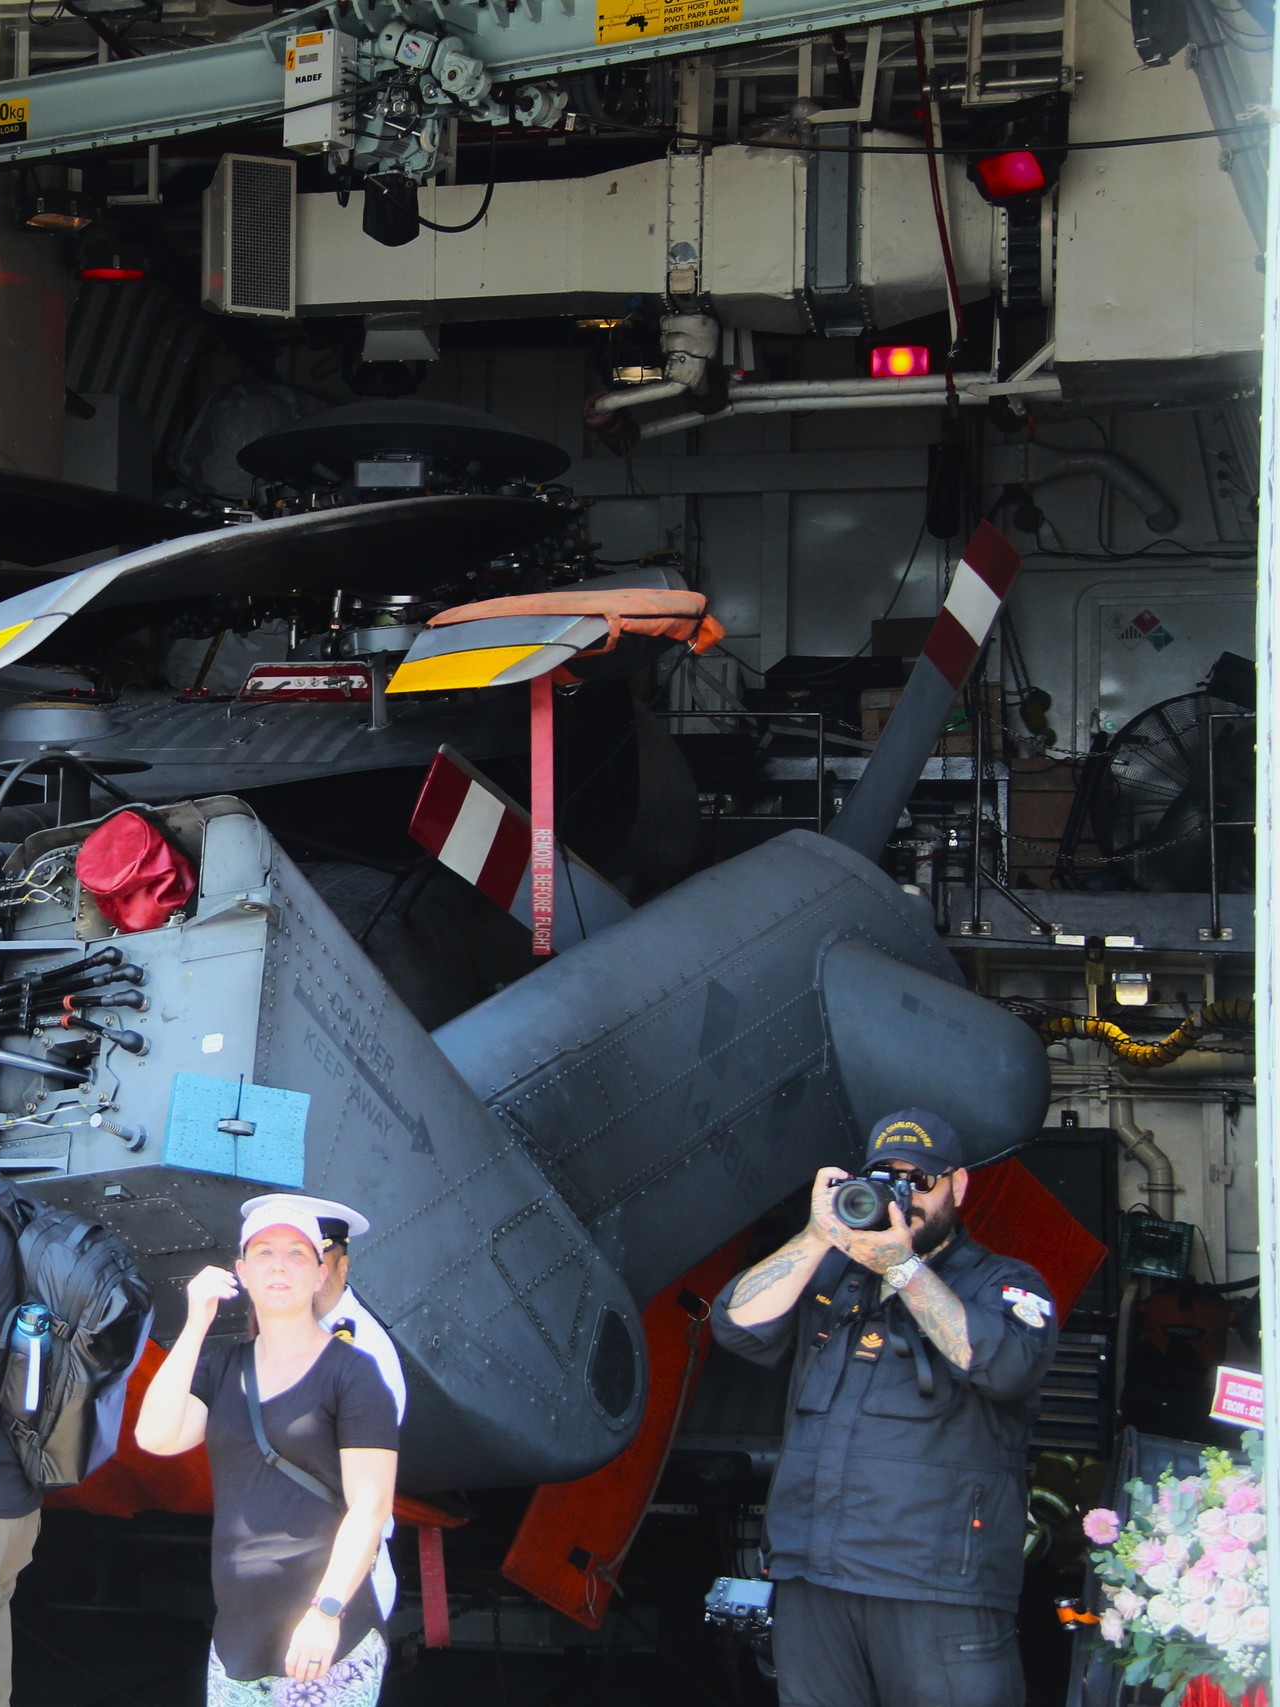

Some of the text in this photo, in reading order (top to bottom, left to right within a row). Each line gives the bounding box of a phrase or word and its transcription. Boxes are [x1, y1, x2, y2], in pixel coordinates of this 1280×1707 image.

[664, 6, 683, 15] PARK
[688, 2, 709, 11] HOIST
[688, 11, 707, 19] PARK
[709, 6, 730, 16] BEAM
[706, 16, 730, 26] LATCH
[295, 73, 322, 84] HADEF
[0, 125, 20, 134] LOAD
[533, 828, 552, 951] REMOVE BEFORE FLIGHT
[330, 991, 395, 1078] DANGER
[303, 1027, 393, 1138] KEEP AWAY
